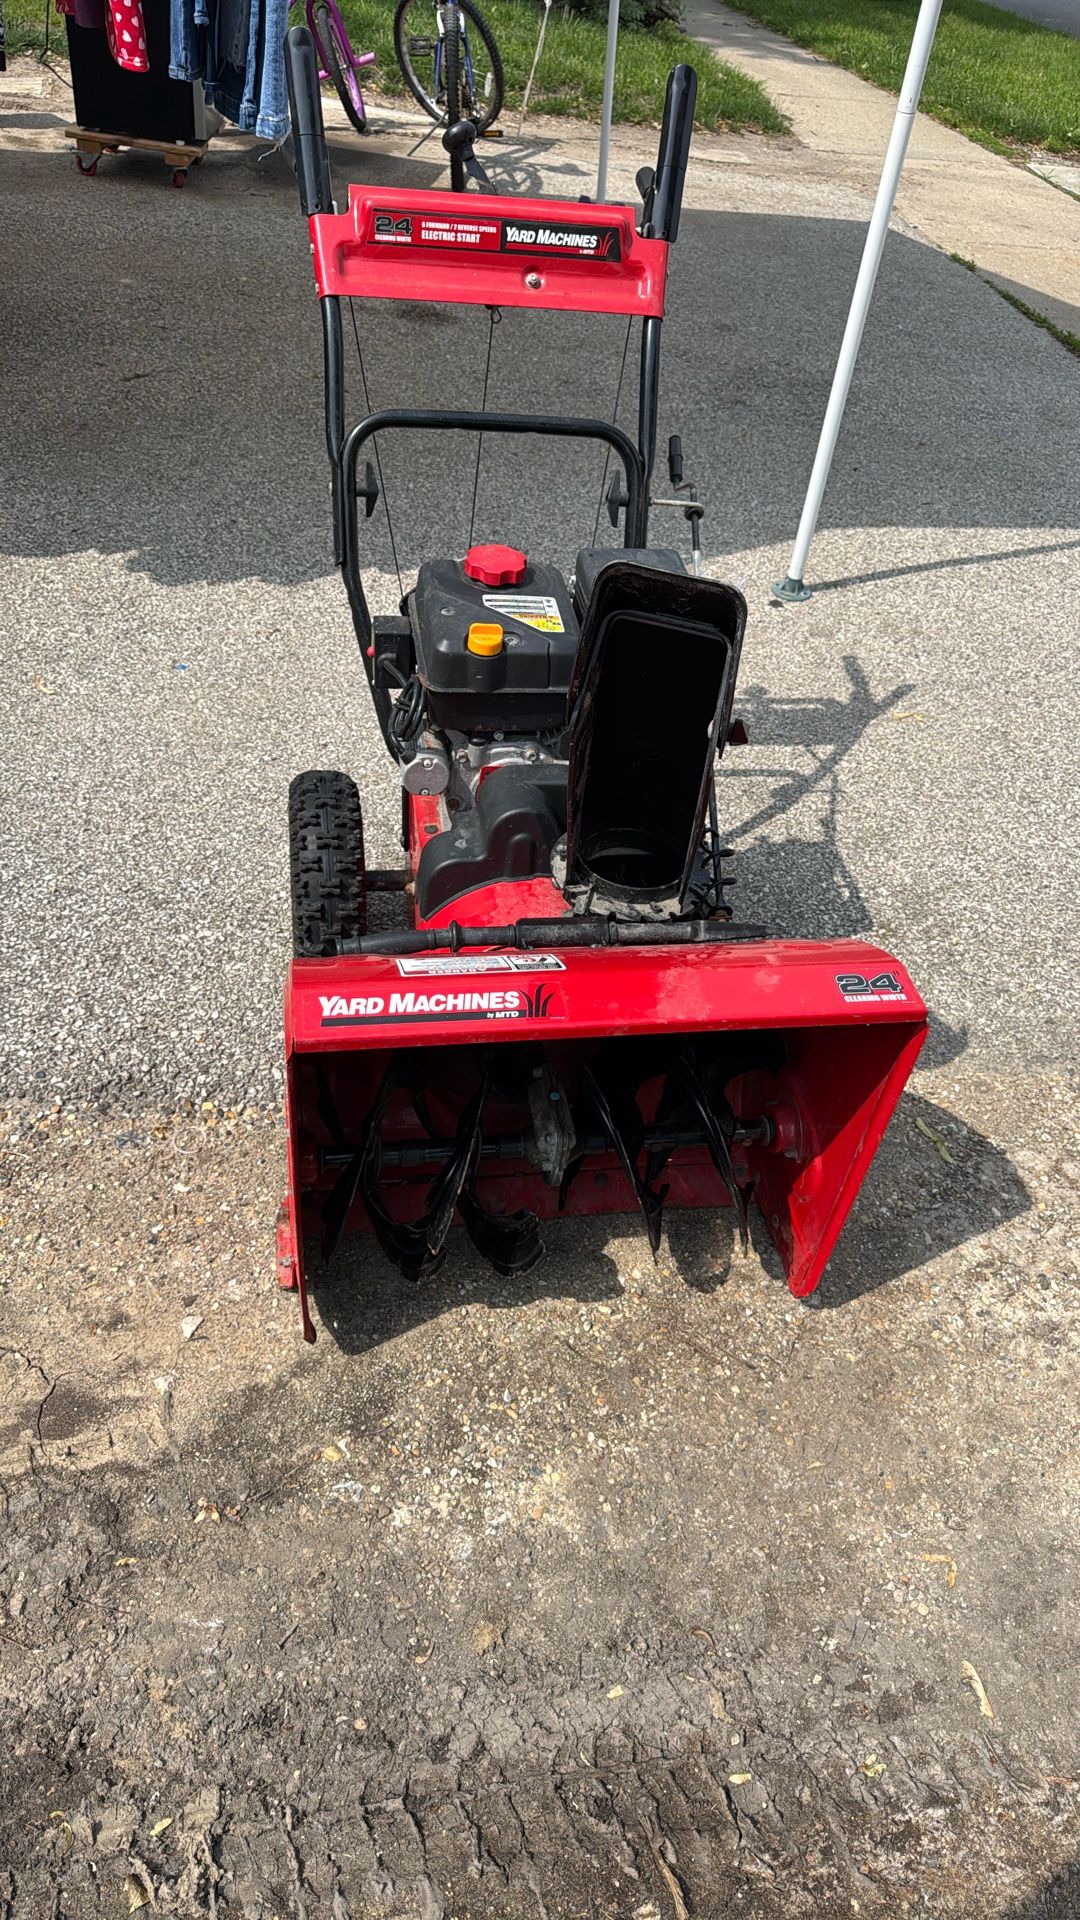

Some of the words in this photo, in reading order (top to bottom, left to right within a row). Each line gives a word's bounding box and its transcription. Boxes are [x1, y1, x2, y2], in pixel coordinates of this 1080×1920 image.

[426, 222, 450, 230] FORWARD
[422, 230, 456, 242] ELECTRIC
[457, 232, 480, 243] START
[506, 226, 536, 243] YARD
[536, 229, 598, 248] MACHINES
[319, 996, 384, 1016] YARD
[388, 991, 520, 1013] MACHINES
